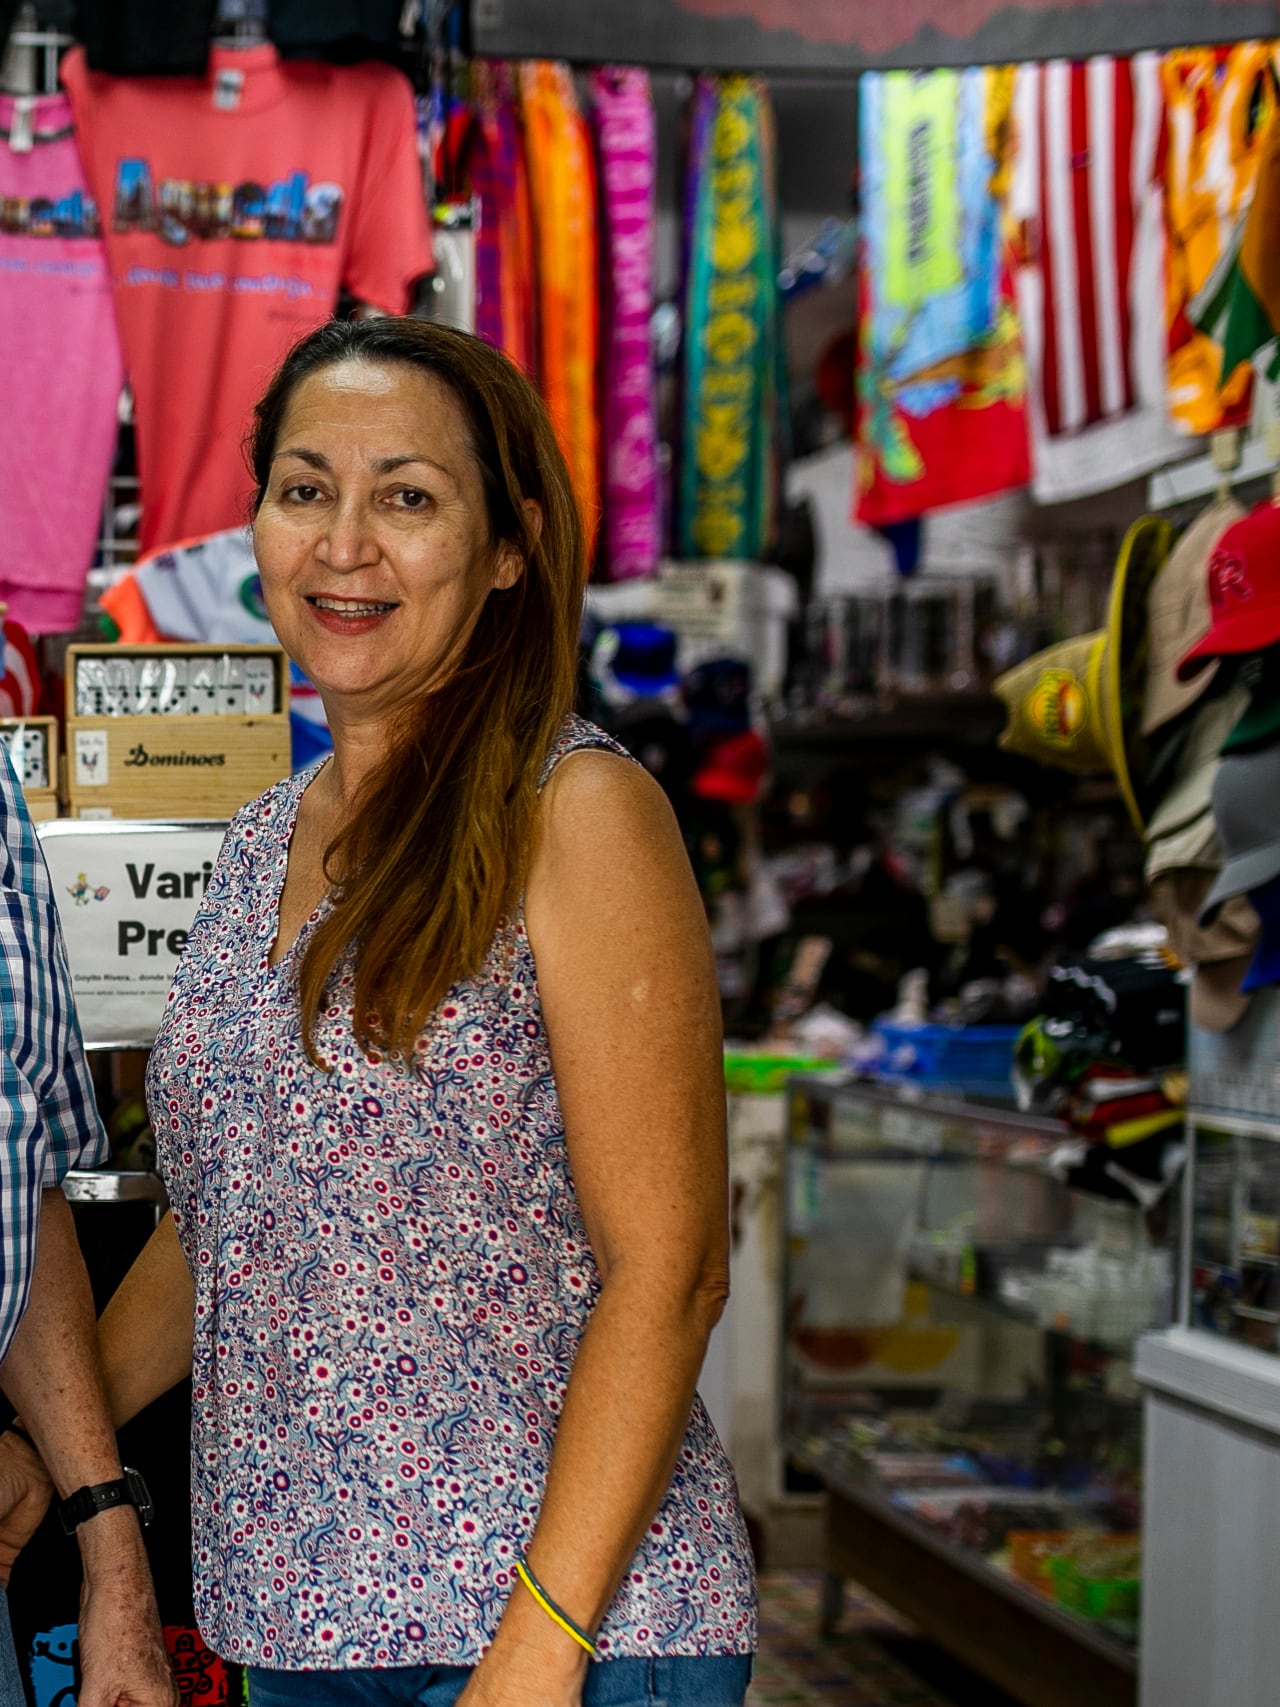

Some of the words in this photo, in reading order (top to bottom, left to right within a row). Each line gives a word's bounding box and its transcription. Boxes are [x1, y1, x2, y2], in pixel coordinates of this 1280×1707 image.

[124, 743, 227, 768] Dominoes
[125, 861, 213, 899] Vari
[118, 920, 188, 957] Pre
